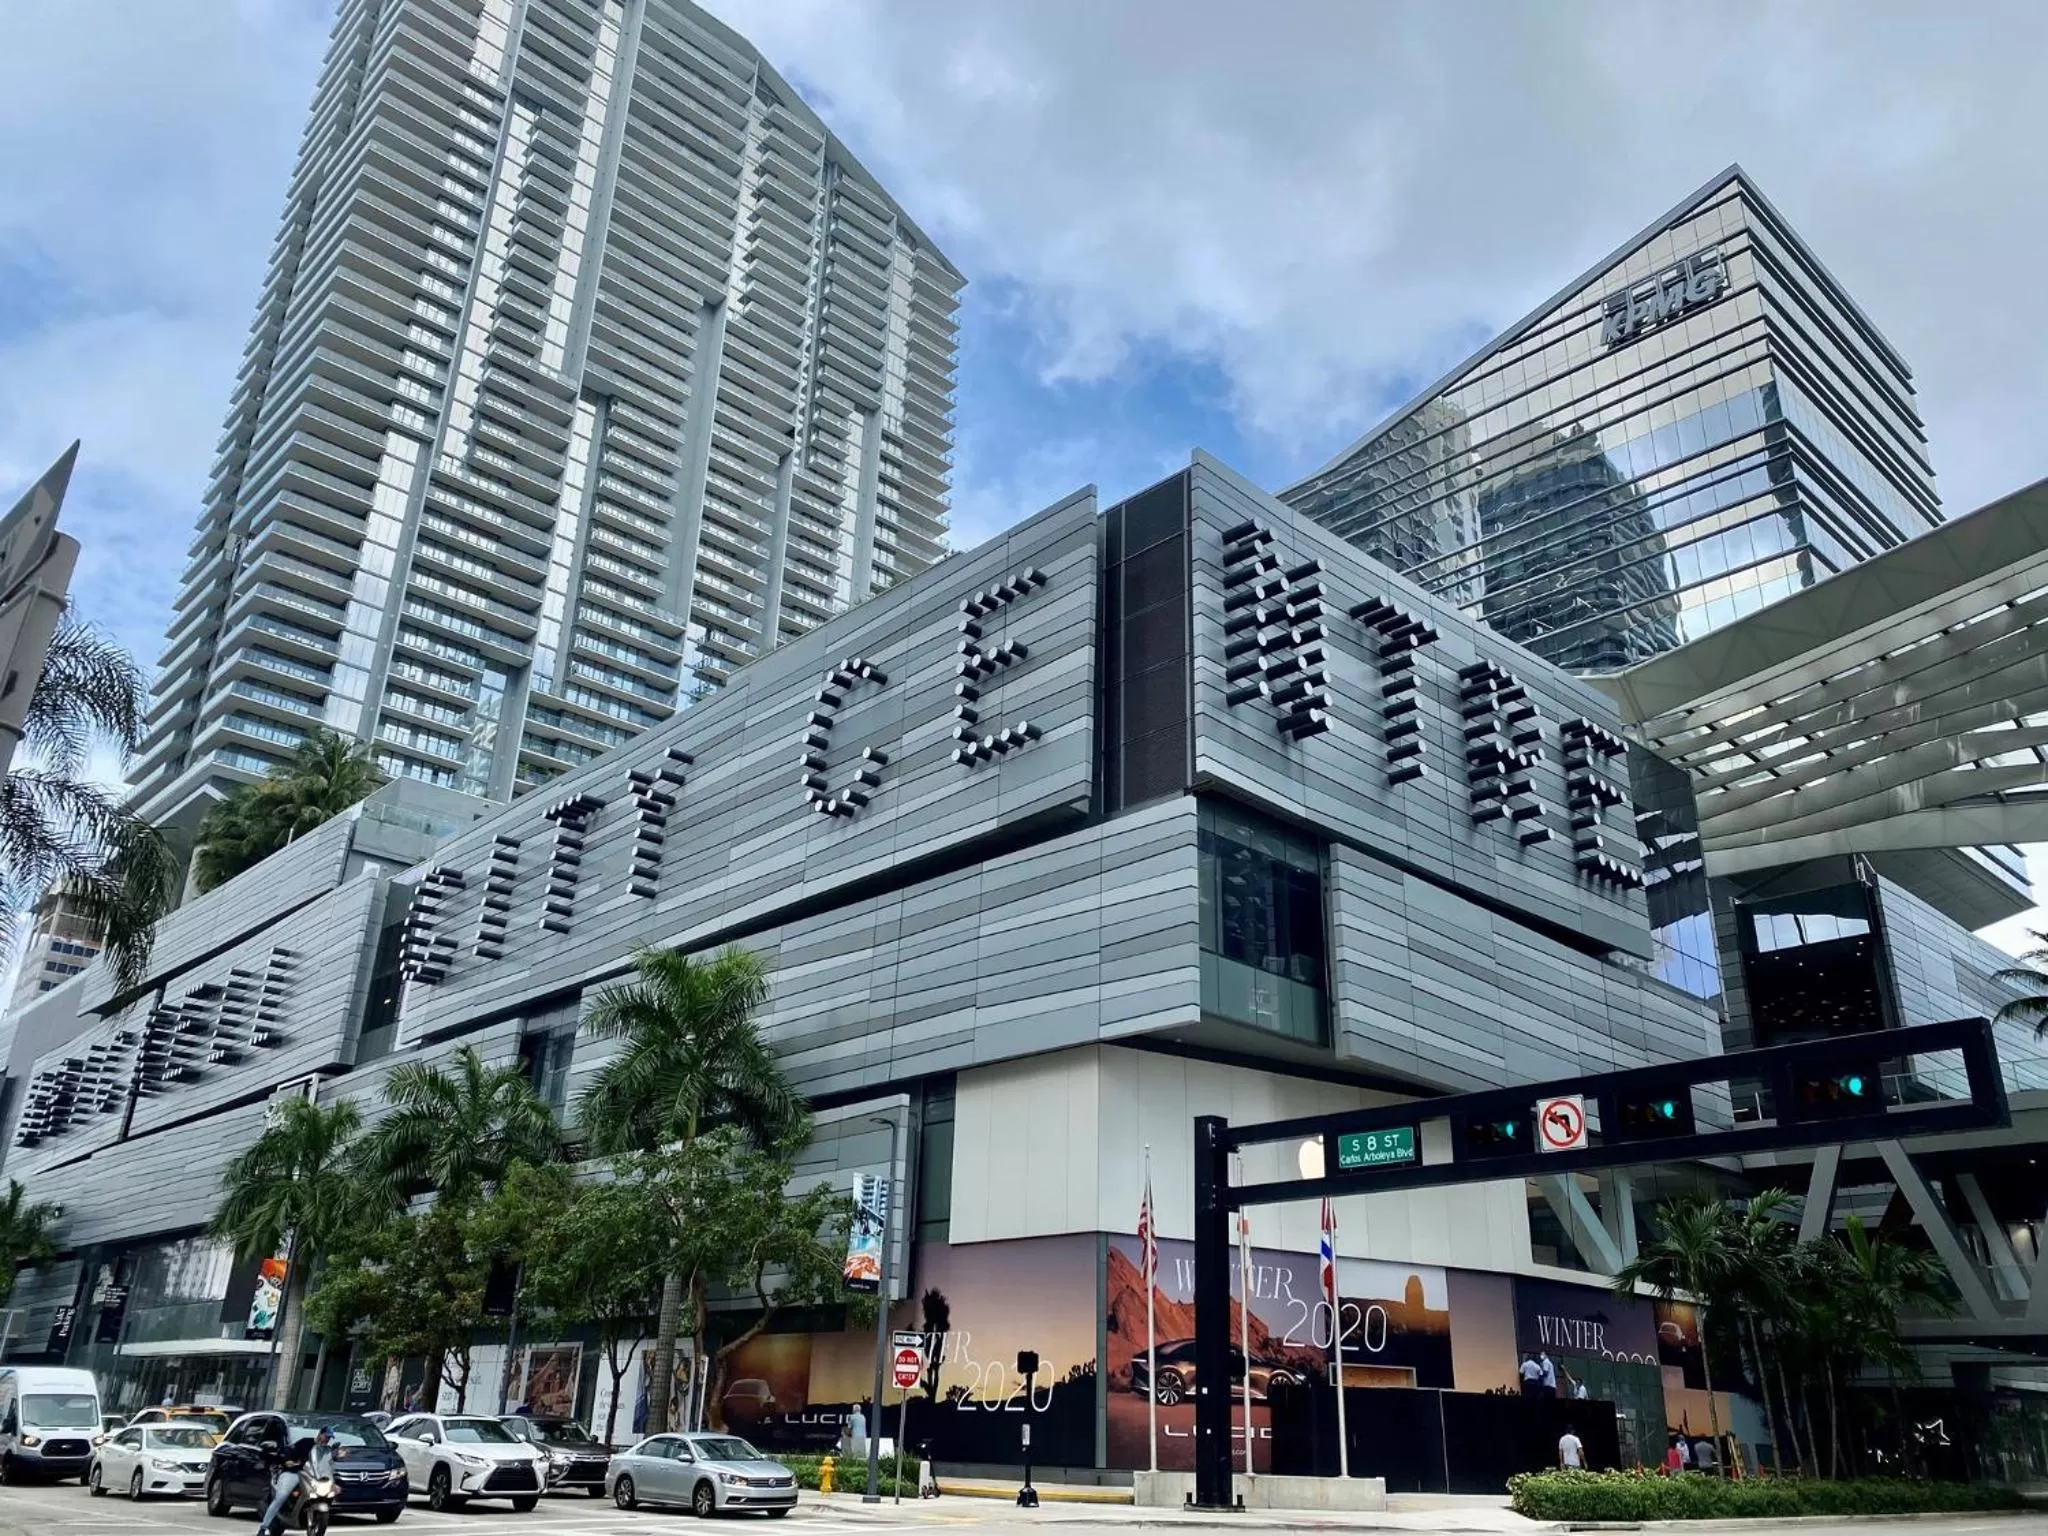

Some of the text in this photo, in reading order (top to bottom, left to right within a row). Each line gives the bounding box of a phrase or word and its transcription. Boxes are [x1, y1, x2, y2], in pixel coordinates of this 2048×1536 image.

[1600, 264, 1726, 347] KPMG
[400, 746, 694, 986] CITY
[1340, 1147, 1414, 1164] Carlos Arboleya Blvd
[1352, 1134, 1399, 1152] S 8 ST
[1282, 1298, 1388, 1353] 2020
[1537, 1314, 1606, 1351] WINTER
